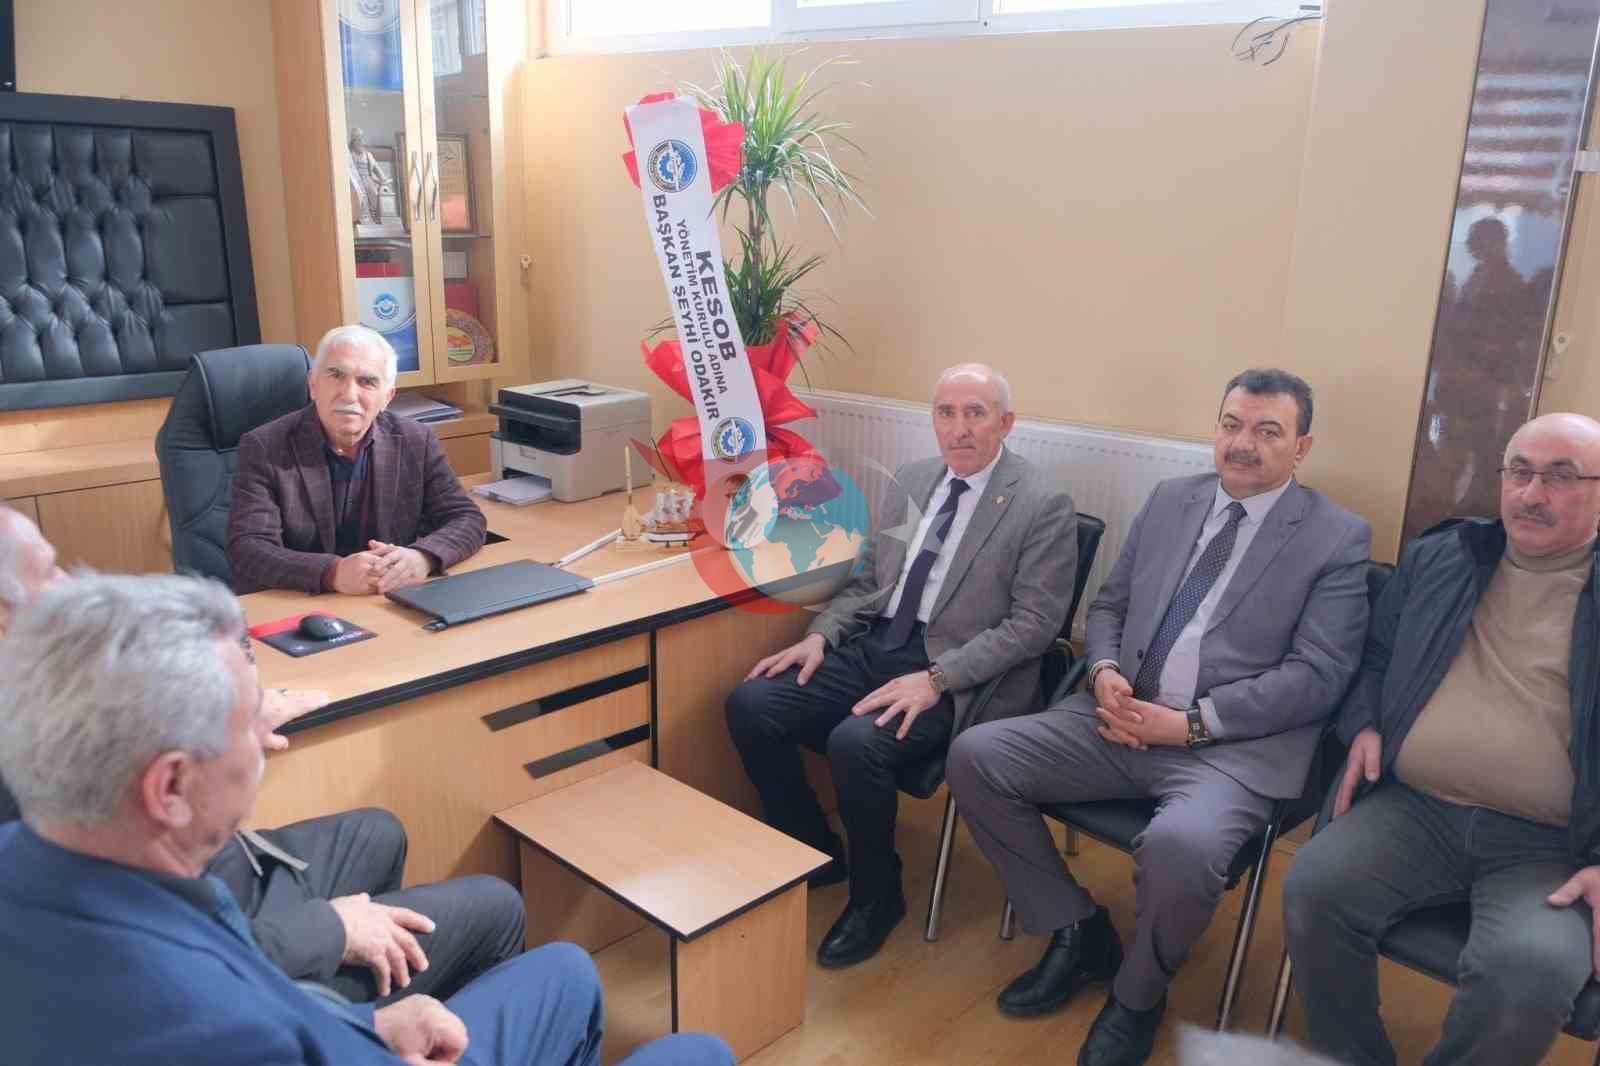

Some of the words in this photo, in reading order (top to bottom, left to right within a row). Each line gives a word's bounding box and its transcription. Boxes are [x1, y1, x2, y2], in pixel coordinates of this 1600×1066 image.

[653, 194, 682, 279] BAŞKAN
[673, 287, 698, 344] ŞEYHİ
[690, 350, 720, 421] ODAKIR
[676, 219, 698, 286] YÖNETİM
[691, 291, 715, 351] KURULU
[708, 354, 728, 394] ADINA
[696, 250, 737, 360] KESOB
